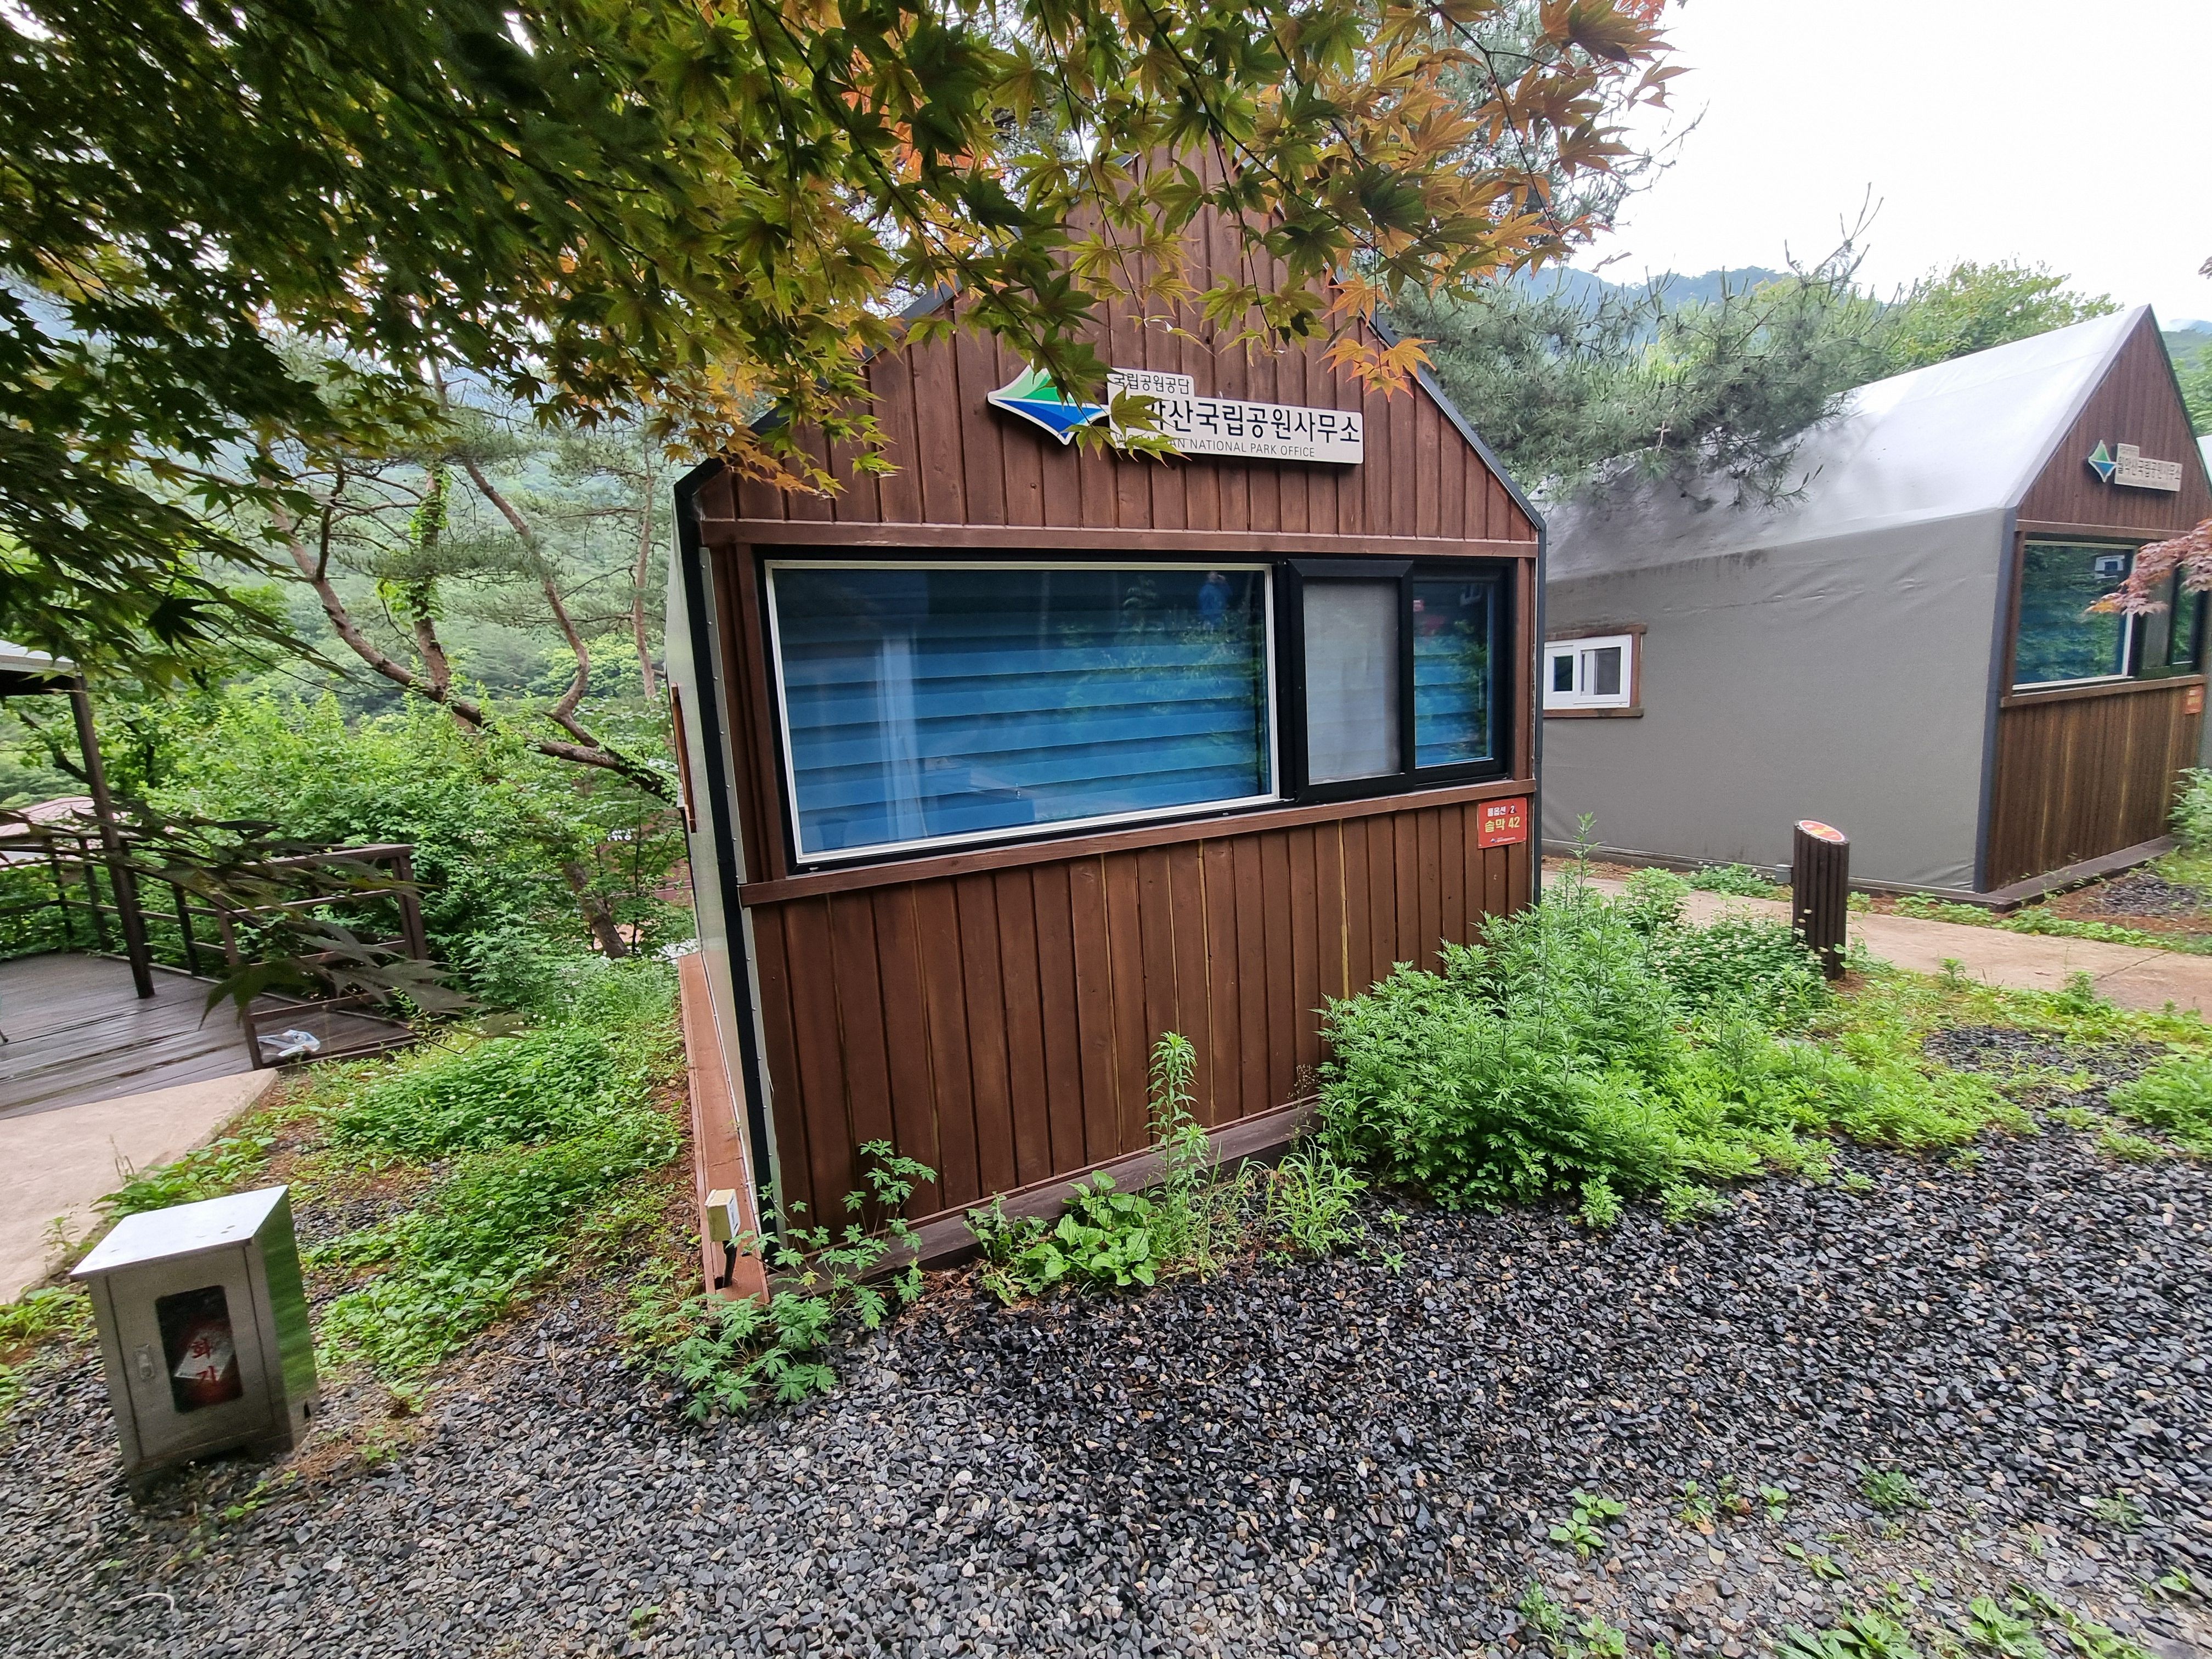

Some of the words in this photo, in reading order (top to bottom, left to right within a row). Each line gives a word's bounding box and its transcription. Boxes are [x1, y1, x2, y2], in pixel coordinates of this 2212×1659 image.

[1113, 373, 1190, 395] 국립공원공단
[1122, 400, 1360, 443] 악산국립공원사무소
[1189, 439, 1247, 453] NATIONAL
[1250, 443, 1277, 455] PARK
[1280, 445, 1315, 458] OFFICE
[1510, 805, 1515, 814] 2
[1508, 816, 1521, 828] 42
